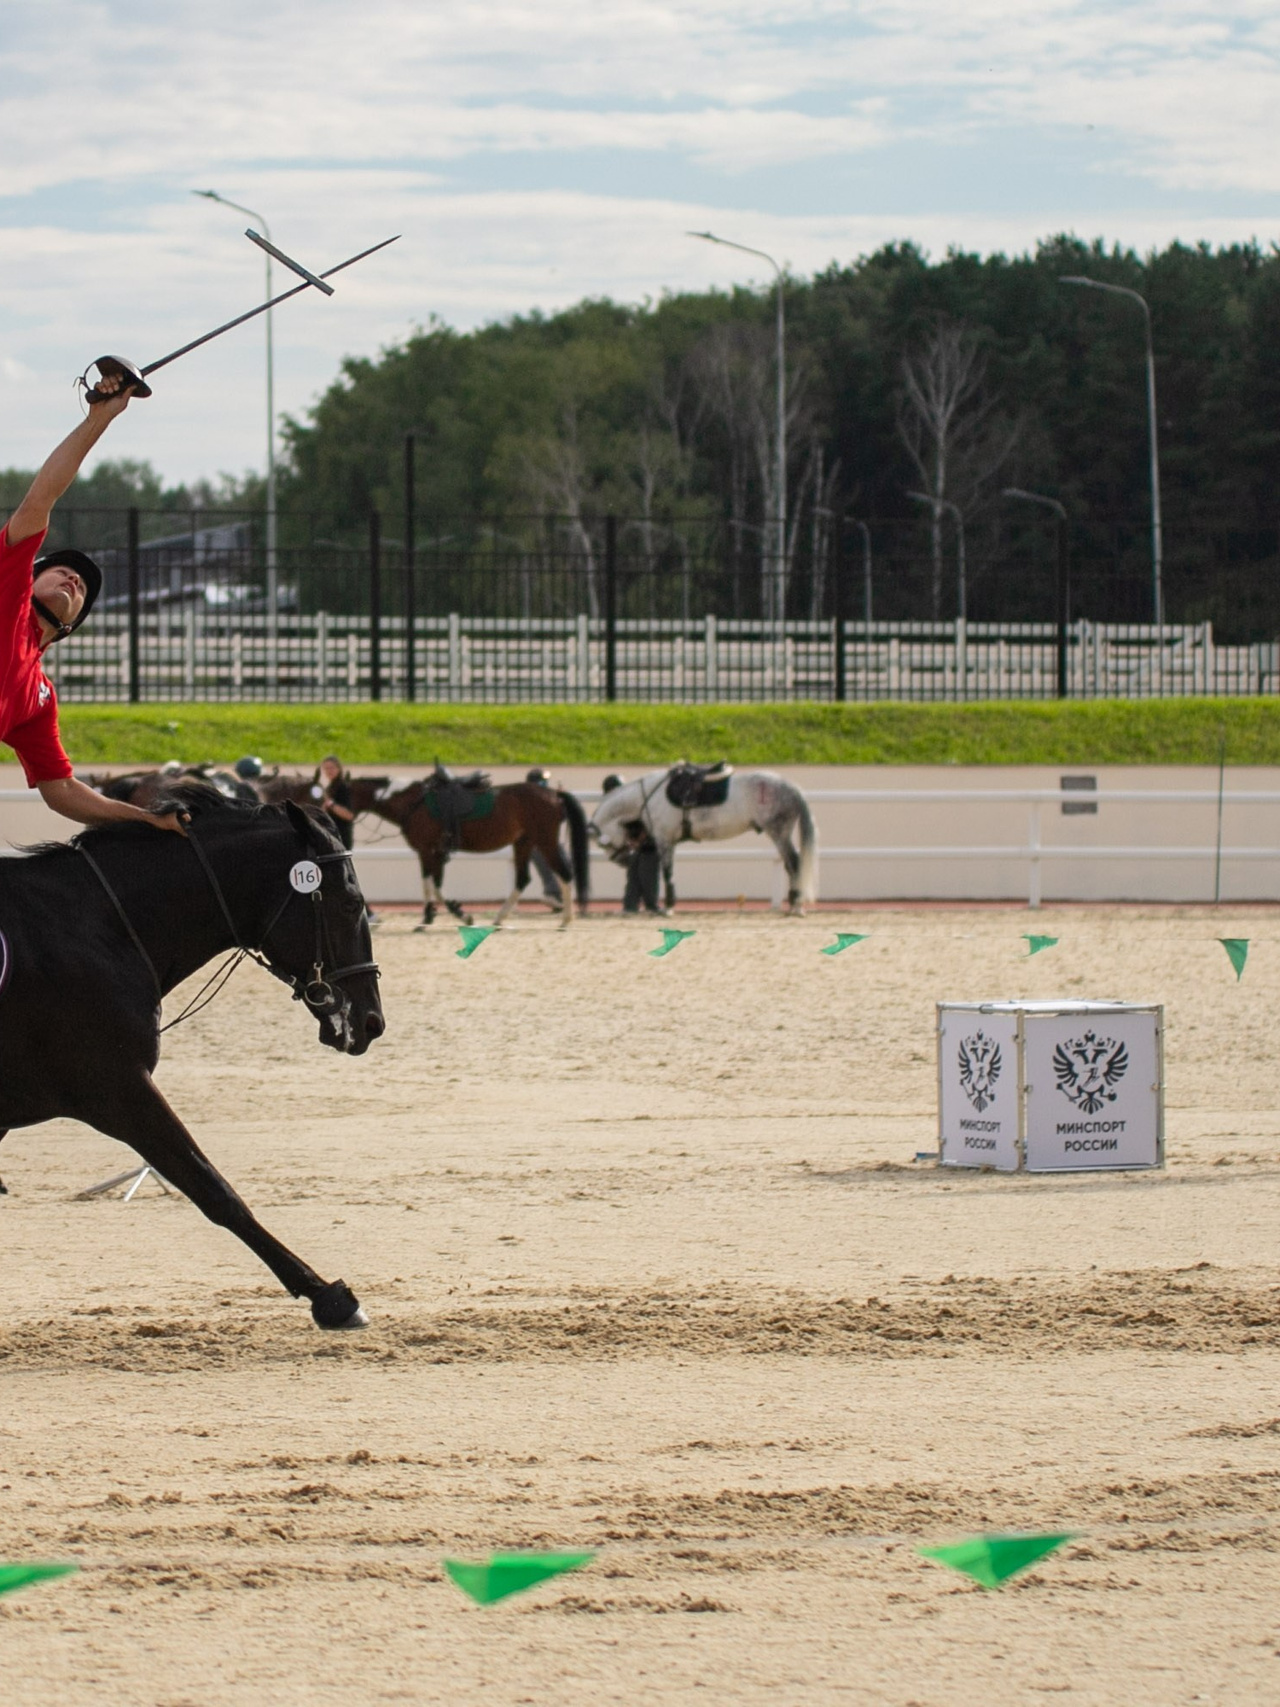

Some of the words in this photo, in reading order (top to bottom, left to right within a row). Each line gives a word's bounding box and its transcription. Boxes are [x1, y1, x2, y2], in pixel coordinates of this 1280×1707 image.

[959, 1118, 1001, 1134] МИНСПОРТ
[1056, 1120, 1127, 1135] МИНСПОРТ
[964, 1136, 997, 1151] РОССИИ
[1064, 1138, 1118, 1153] РОССИИ
